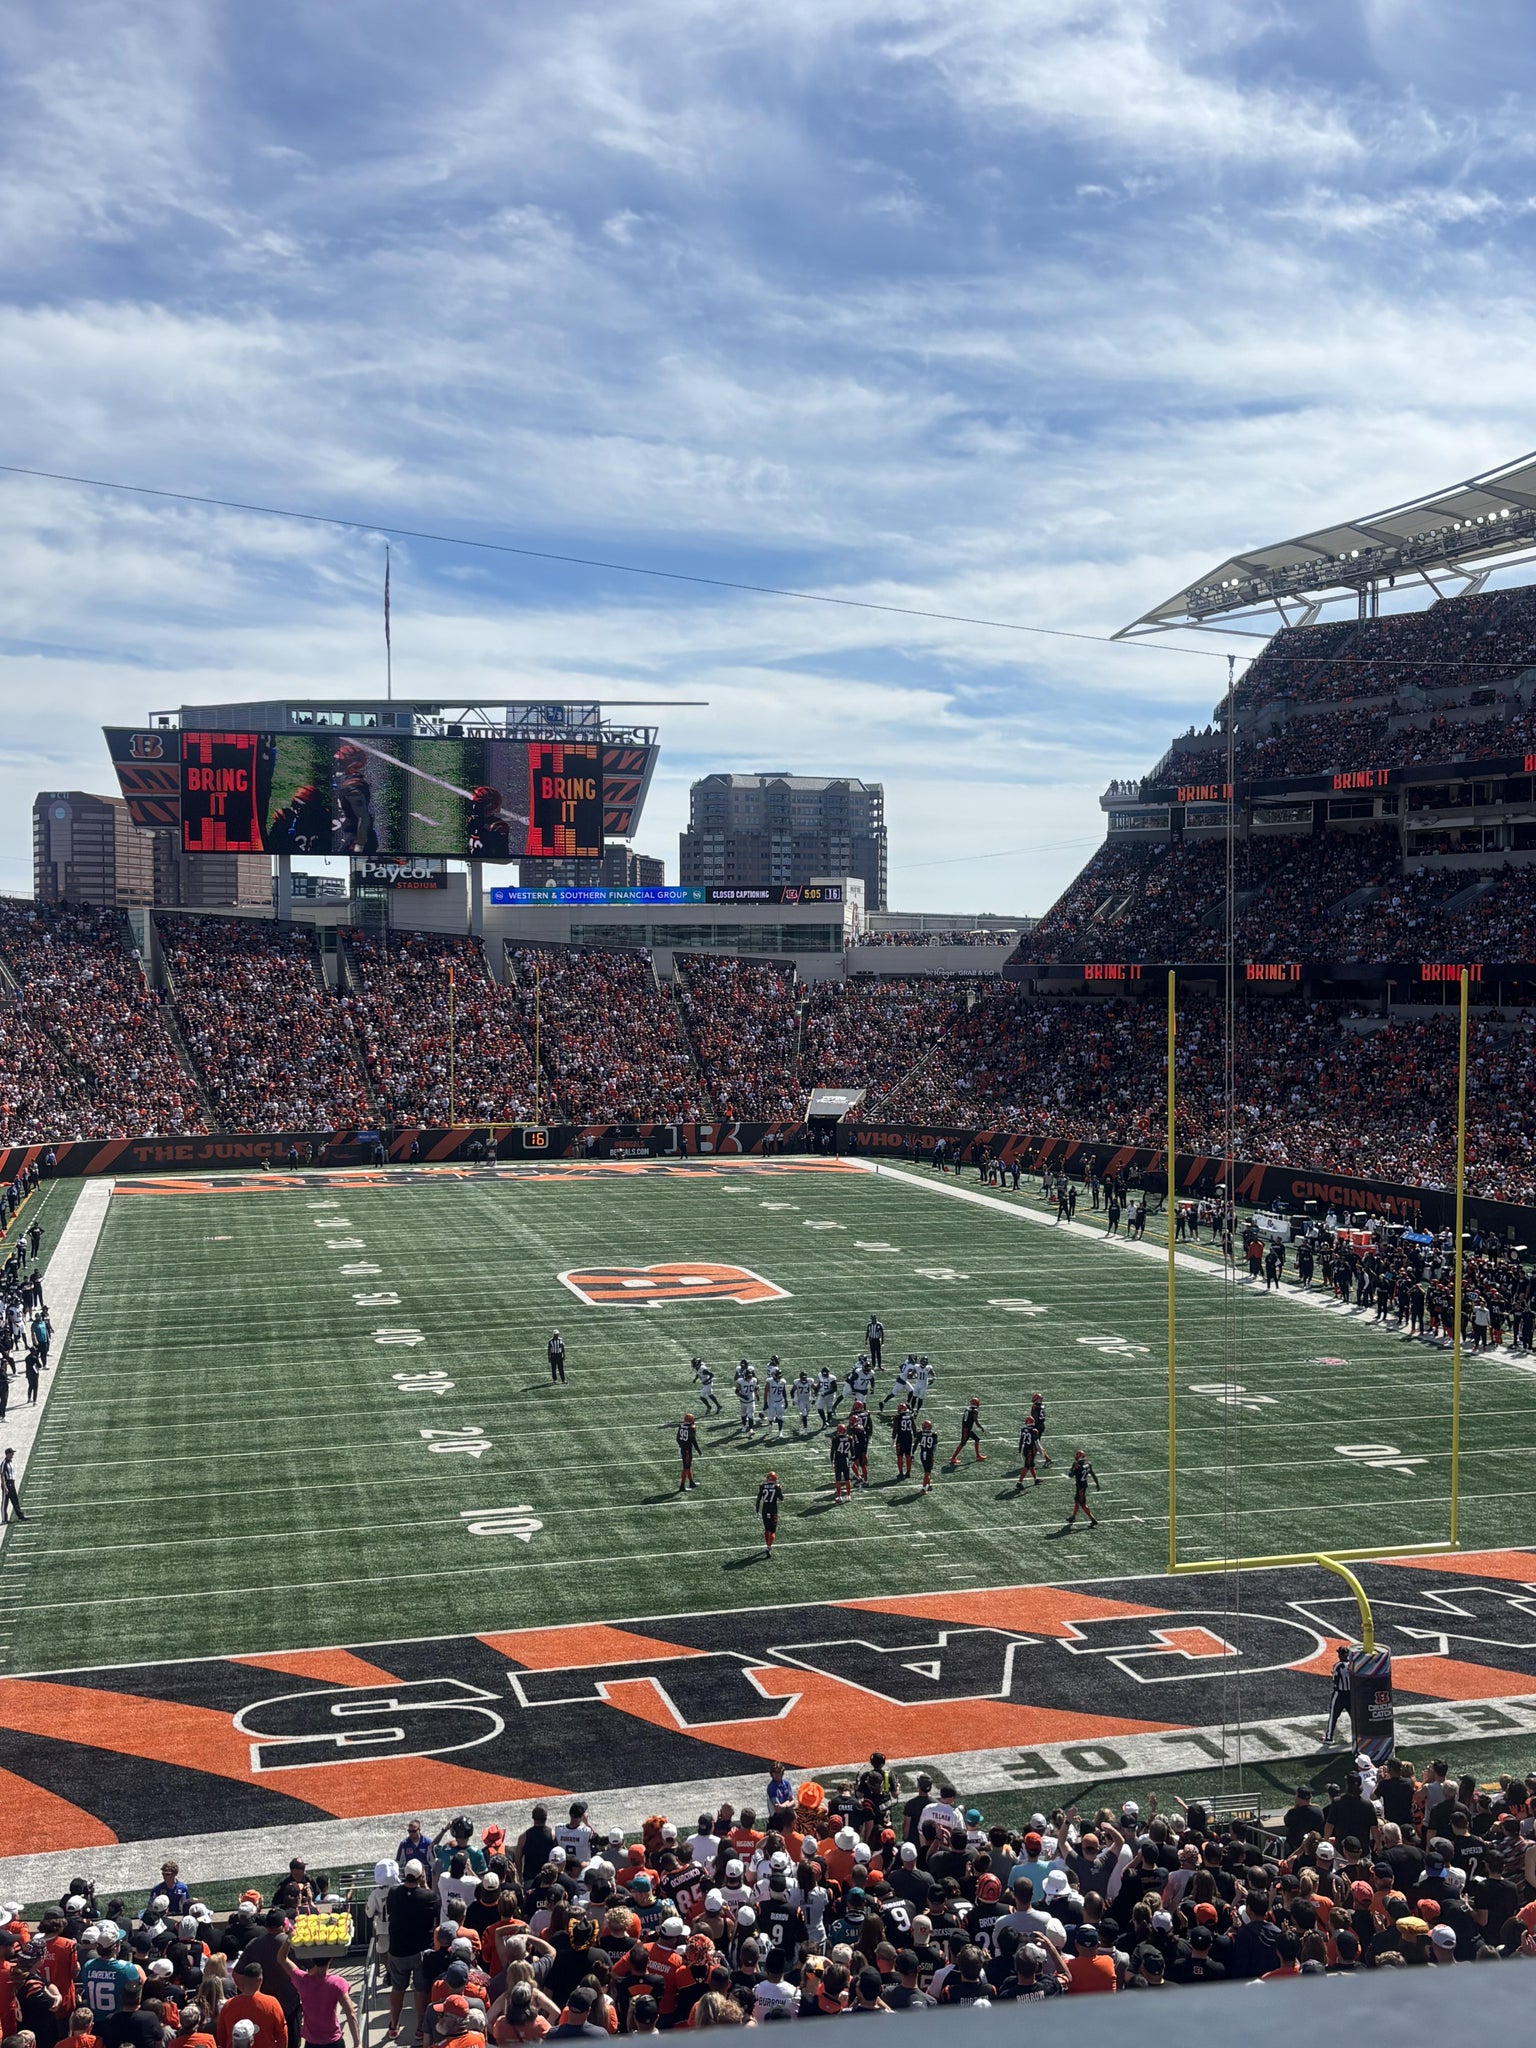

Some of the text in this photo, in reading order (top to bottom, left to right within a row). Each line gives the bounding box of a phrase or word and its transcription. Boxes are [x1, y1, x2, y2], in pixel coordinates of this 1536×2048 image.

[188, 767, 248, 792] BRING
[541, 776, 596, 799] BRING
[1333, 769, 1389, 790] BRING IT
[1177, 783, 1233, 802] BRING IT
[210, 792, 228, 815] IT
[561, 800, 577, 822] IT
[560, 891, 606, 899] SOUTHERN
[609, 891, 655, 899] FINANCIAL
[658, 891, 687, 899] GROUP
[713, 891, 770, 899] CLOSED CAPTIONING
[804, 889, 821, 898] 5:05
[828, 890, 838, 899] 16
[1084, 964, 1142, 980] BRING IT
[1246, 964, 1302, 980] BRING IT
[1470, 964, 1483, 980] IT
[531, 1132, 545, 1146] 16
[856, 1132, 902, 1146] WHO
[133, 1146, 193, 1161] THE
[352, 1291, 402, 1306] 50
[1076, 1336, 1150, 1354] 30
[392, 1371, 455, 1391] 30
[1188, 1383, 1279, 1404] 20
[901, 1419, 912, 1431] 93
[419, 1426, 493, 1453] 20
[680, 1428, 689, 1441] 99
[920, 1436, 934, 1449] 49
[837, 1441, 851, 1454] 42
[1334, 1444, 1429, 1468] 10
[762, 1489, 776, 1503] 27
[459, 1504, 543, 1536] 10
[1001, 1743, 1128, 1782] OF
[932, 1812, 951, 1821] TILLMAN
[736, 1840, 755, 1848] HIGGINS
[670, 1868, 700, 1888] OCHOCINCO
[675, 1882, 702, 1915] 85
[890, 1907, 911, 1932] 9
[772, 1924, 784, 1945] 9
[845, 1929, 859, 1937] SMI
[608, 1950, 626, 1959] CHAS
[87, 1970, 117, 1980] LAWRENCE
[87, 1980, 116, 2011] 16
[758, 1996, 787, 2007] BURROW
